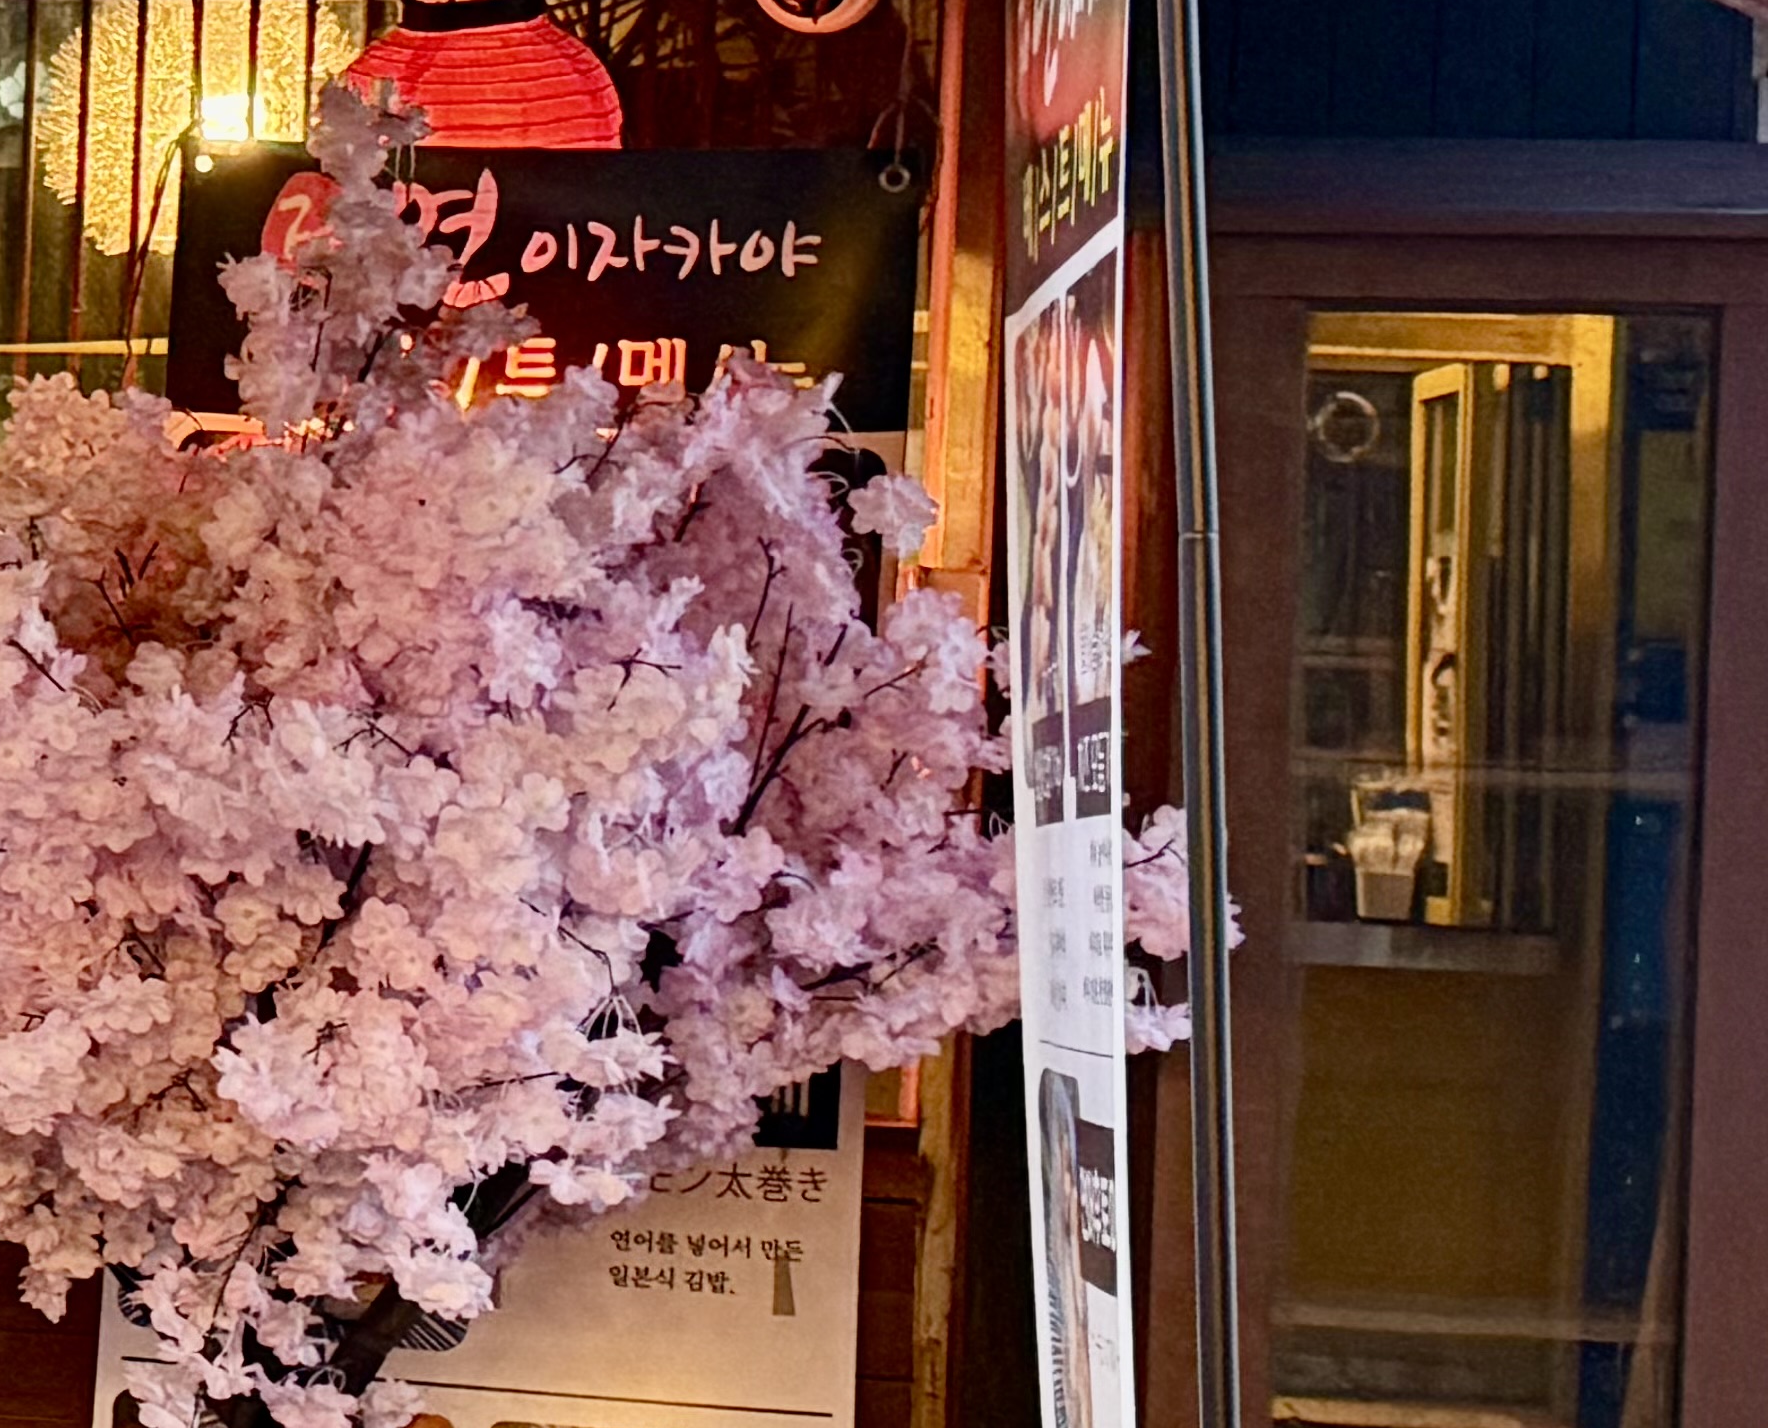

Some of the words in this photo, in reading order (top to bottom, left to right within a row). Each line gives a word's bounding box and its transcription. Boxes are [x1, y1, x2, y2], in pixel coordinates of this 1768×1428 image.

[521, 215, 821, 281] 이자카야
[610, 1229, 678, 1255] 연어를
[687, 1233, 752, 1259] 넣어서
[761, 1238, 803, 1262] 만든
[609, 1264, 675, 1290] 일본식
